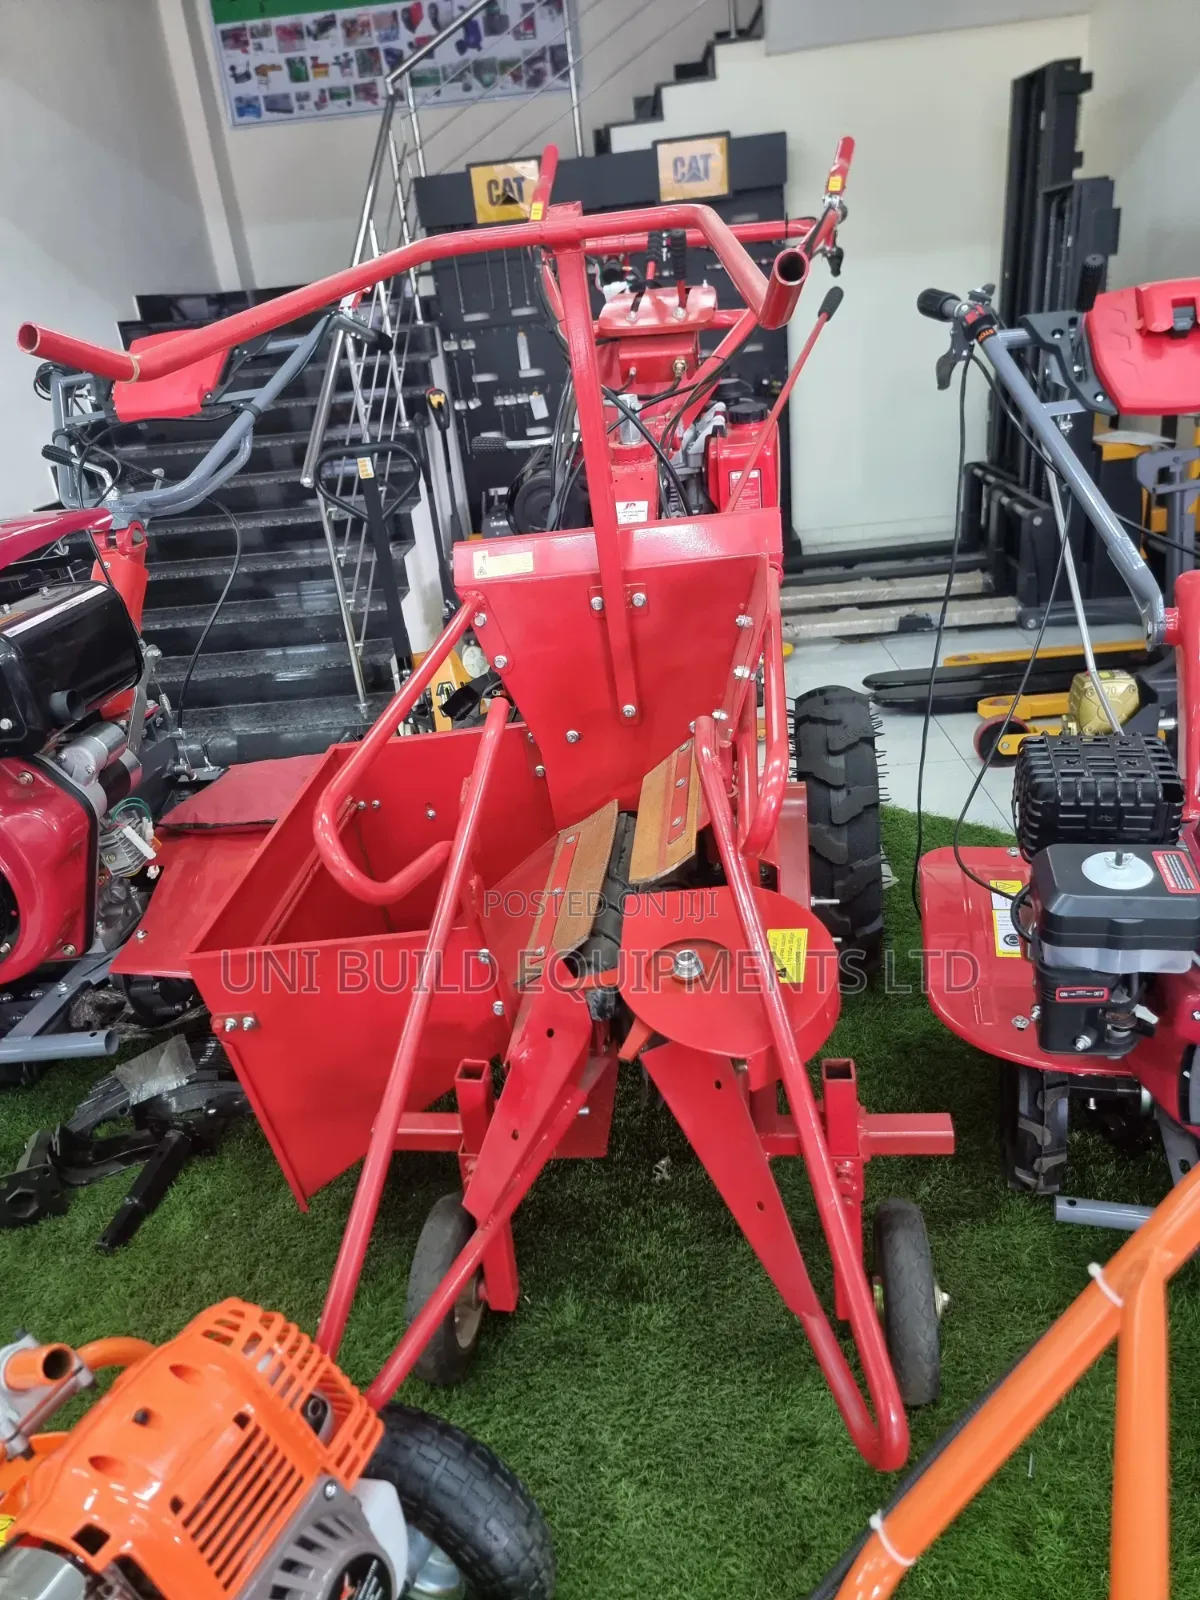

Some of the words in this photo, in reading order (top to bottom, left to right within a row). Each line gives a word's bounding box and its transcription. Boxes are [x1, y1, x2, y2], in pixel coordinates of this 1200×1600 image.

[673, 152, 712, 184] CAT
[486, 176, 525, 207] CAT
[1106, 686, 1117, 695] 70
